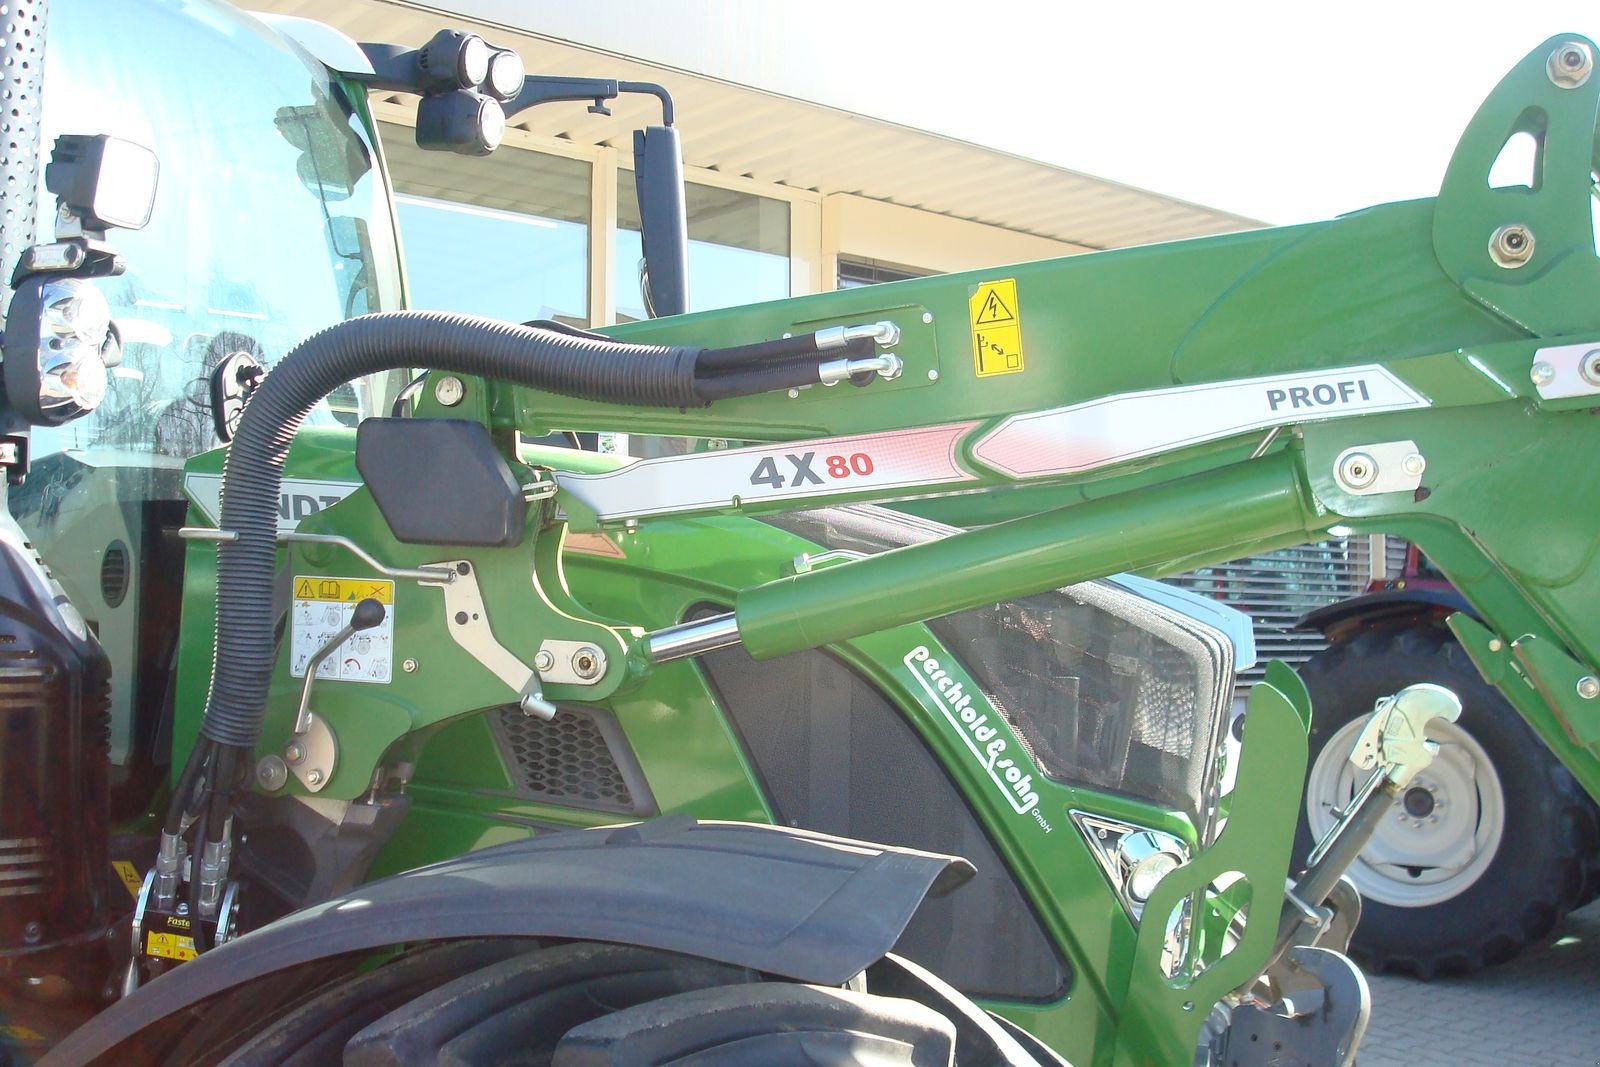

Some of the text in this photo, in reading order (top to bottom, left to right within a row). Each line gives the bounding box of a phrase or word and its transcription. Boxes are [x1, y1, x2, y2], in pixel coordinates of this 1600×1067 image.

[1266, 379, 1370, 411] PROFI
[1031, 808, 1053, 835] GmbH
[167, 916, 191, 927] Faste
